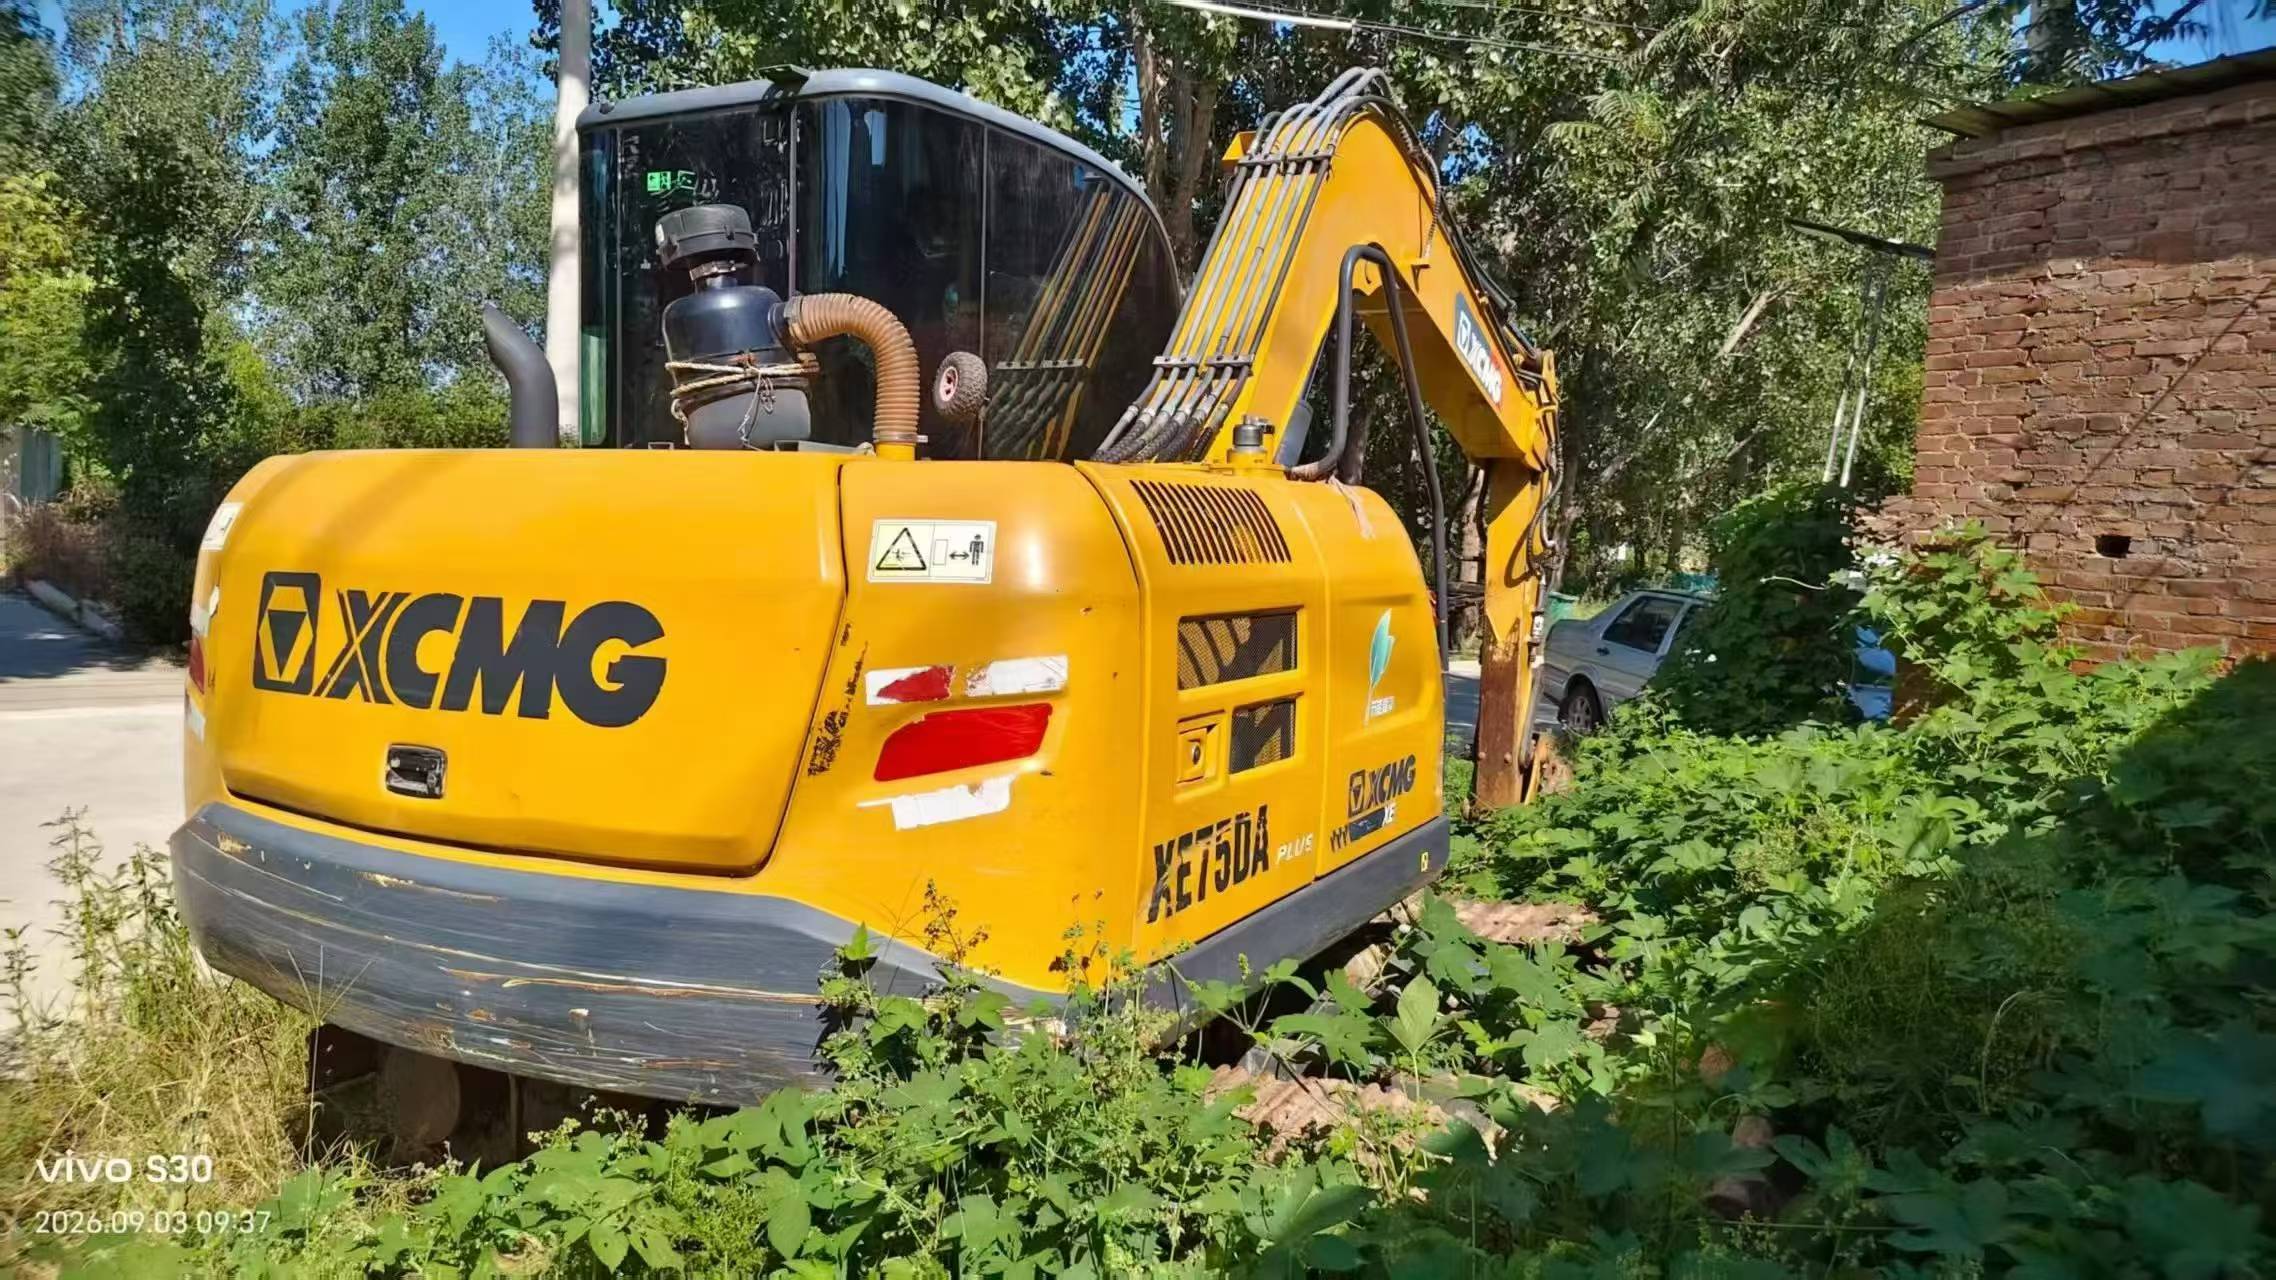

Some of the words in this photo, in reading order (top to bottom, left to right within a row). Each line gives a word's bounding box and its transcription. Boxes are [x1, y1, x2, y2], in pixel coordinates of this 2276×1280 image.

[314, 588, 667, 728] XCMG
[1366, 754, 1416, 809] XCMG
[1146, 804, 1269, 924] XE75DA
[1276, 833, 1313, 864] PLUS
